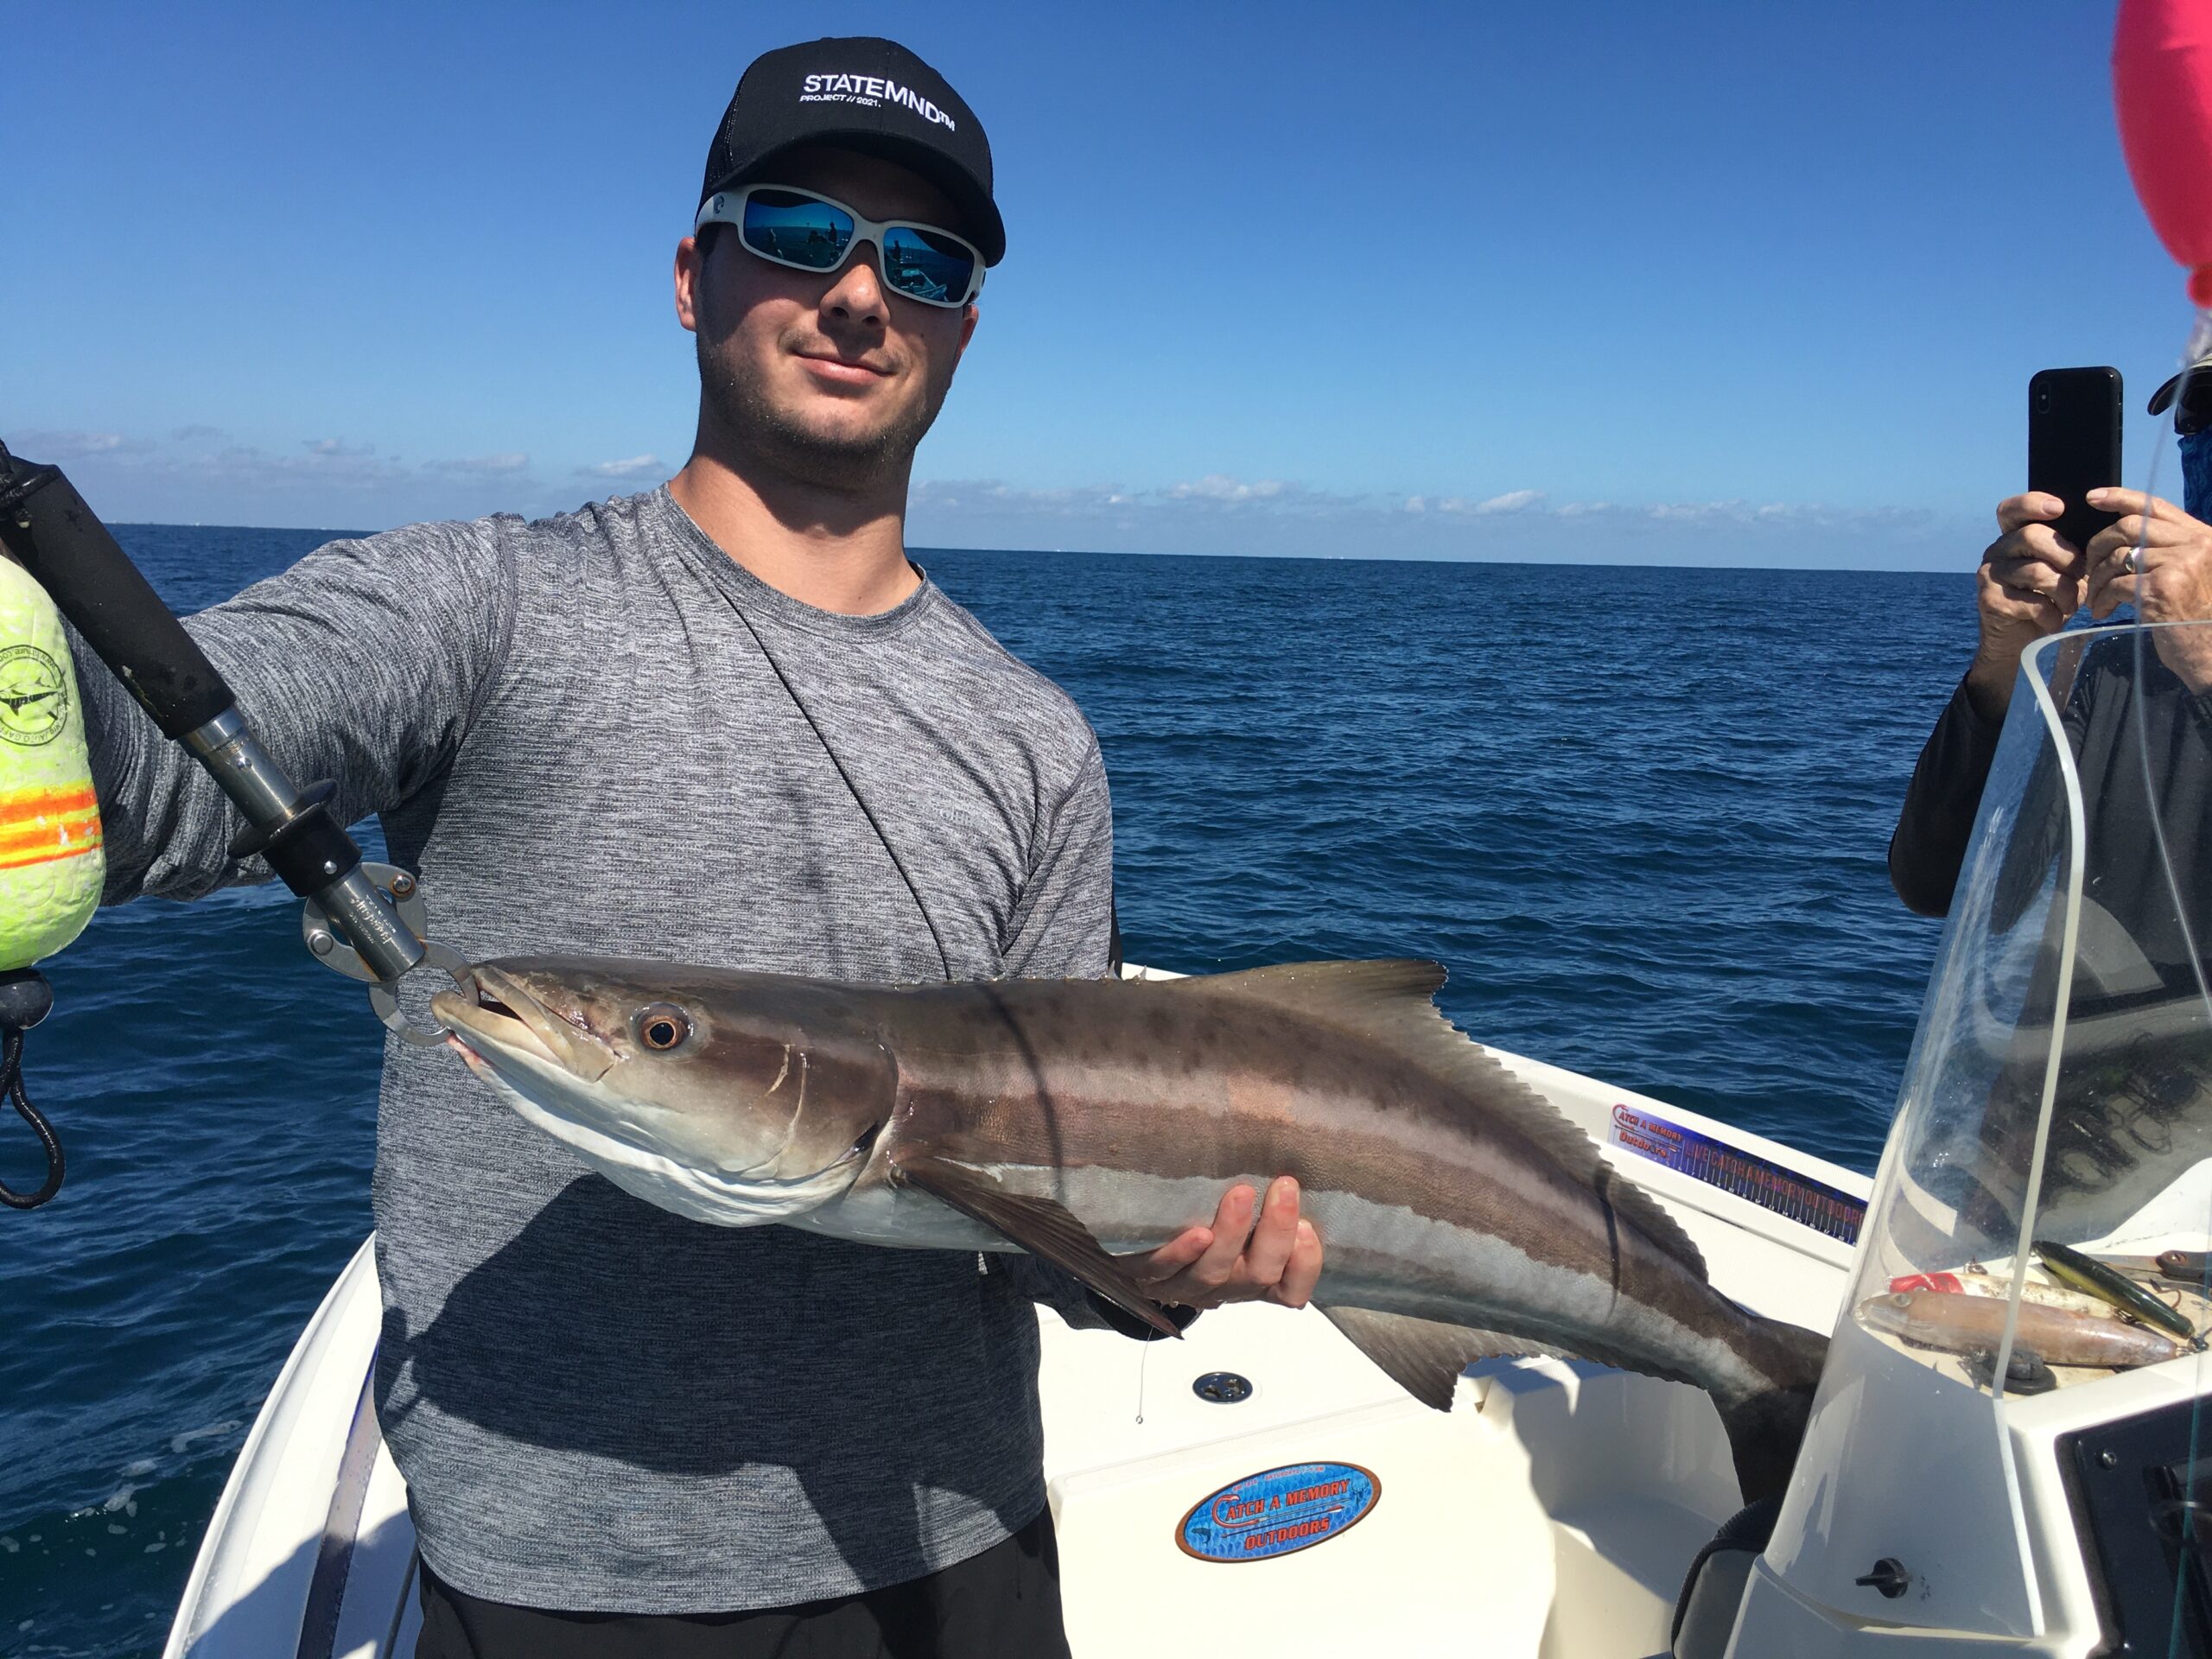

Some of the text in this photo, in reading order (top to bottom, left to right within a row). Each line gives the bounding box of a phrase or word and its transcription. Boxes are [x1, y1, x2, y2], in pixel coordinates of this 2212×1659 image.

[799, 94, 846, 103] PROJECT
[856, 97, 882, 107] 2021.
[1640, 1119, 1647, 1129] A
[1649, 1122, 1683, 1141] MEMORY
[1711, 1149, 1745, 1177] CATCH
[1754, 1168, 1804, 1199] MEMORY
[1211, 1478, 1351, 1529] CATCH A MEMORY
[1244, 1517, 1330, 1550] OUTDOORS
